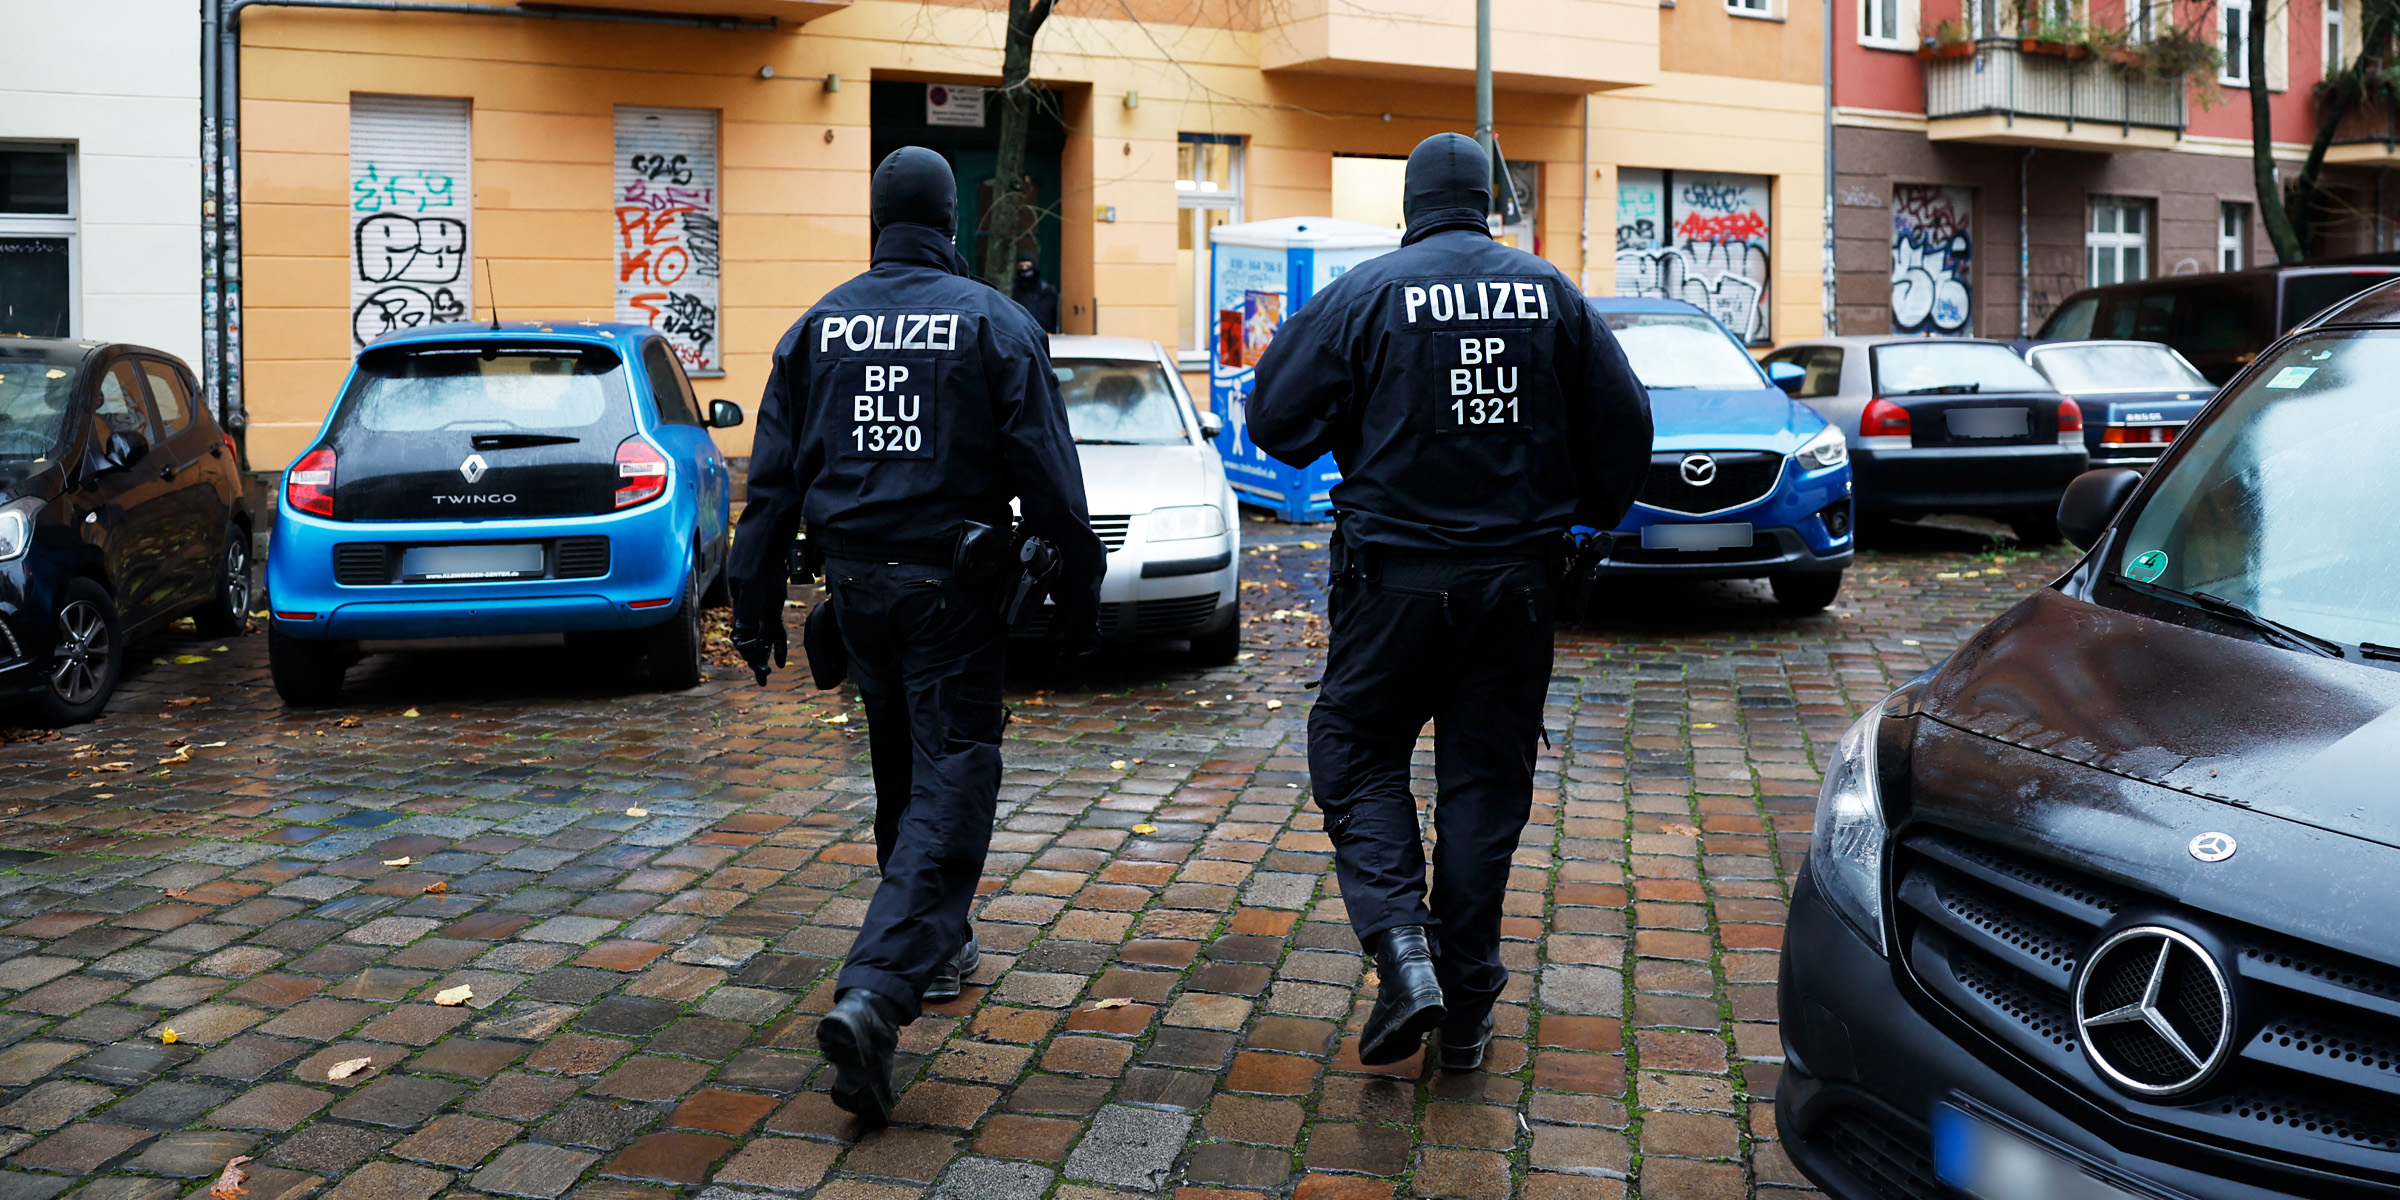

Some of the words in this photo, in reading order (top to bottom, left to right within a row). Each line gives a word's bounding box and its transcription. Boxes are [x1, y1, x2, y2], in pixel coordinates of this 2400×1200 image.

[1404, 282, 1549, 323] POLIZEI
[820, 314, 959, 353] POLIZEI
[1460, 337, 1506, 365] BP
[865, 365, 909, 392] BP
[1450, 366, 1518, 396] BLU
[854, 395, 920, 422] BLU
[1451, 397, 1519, 425] 1321
[851, 425, 922, 452] 1320
[432, 493, 517, 505] TWINGO
[2144, 552, 2159, 568] 4
